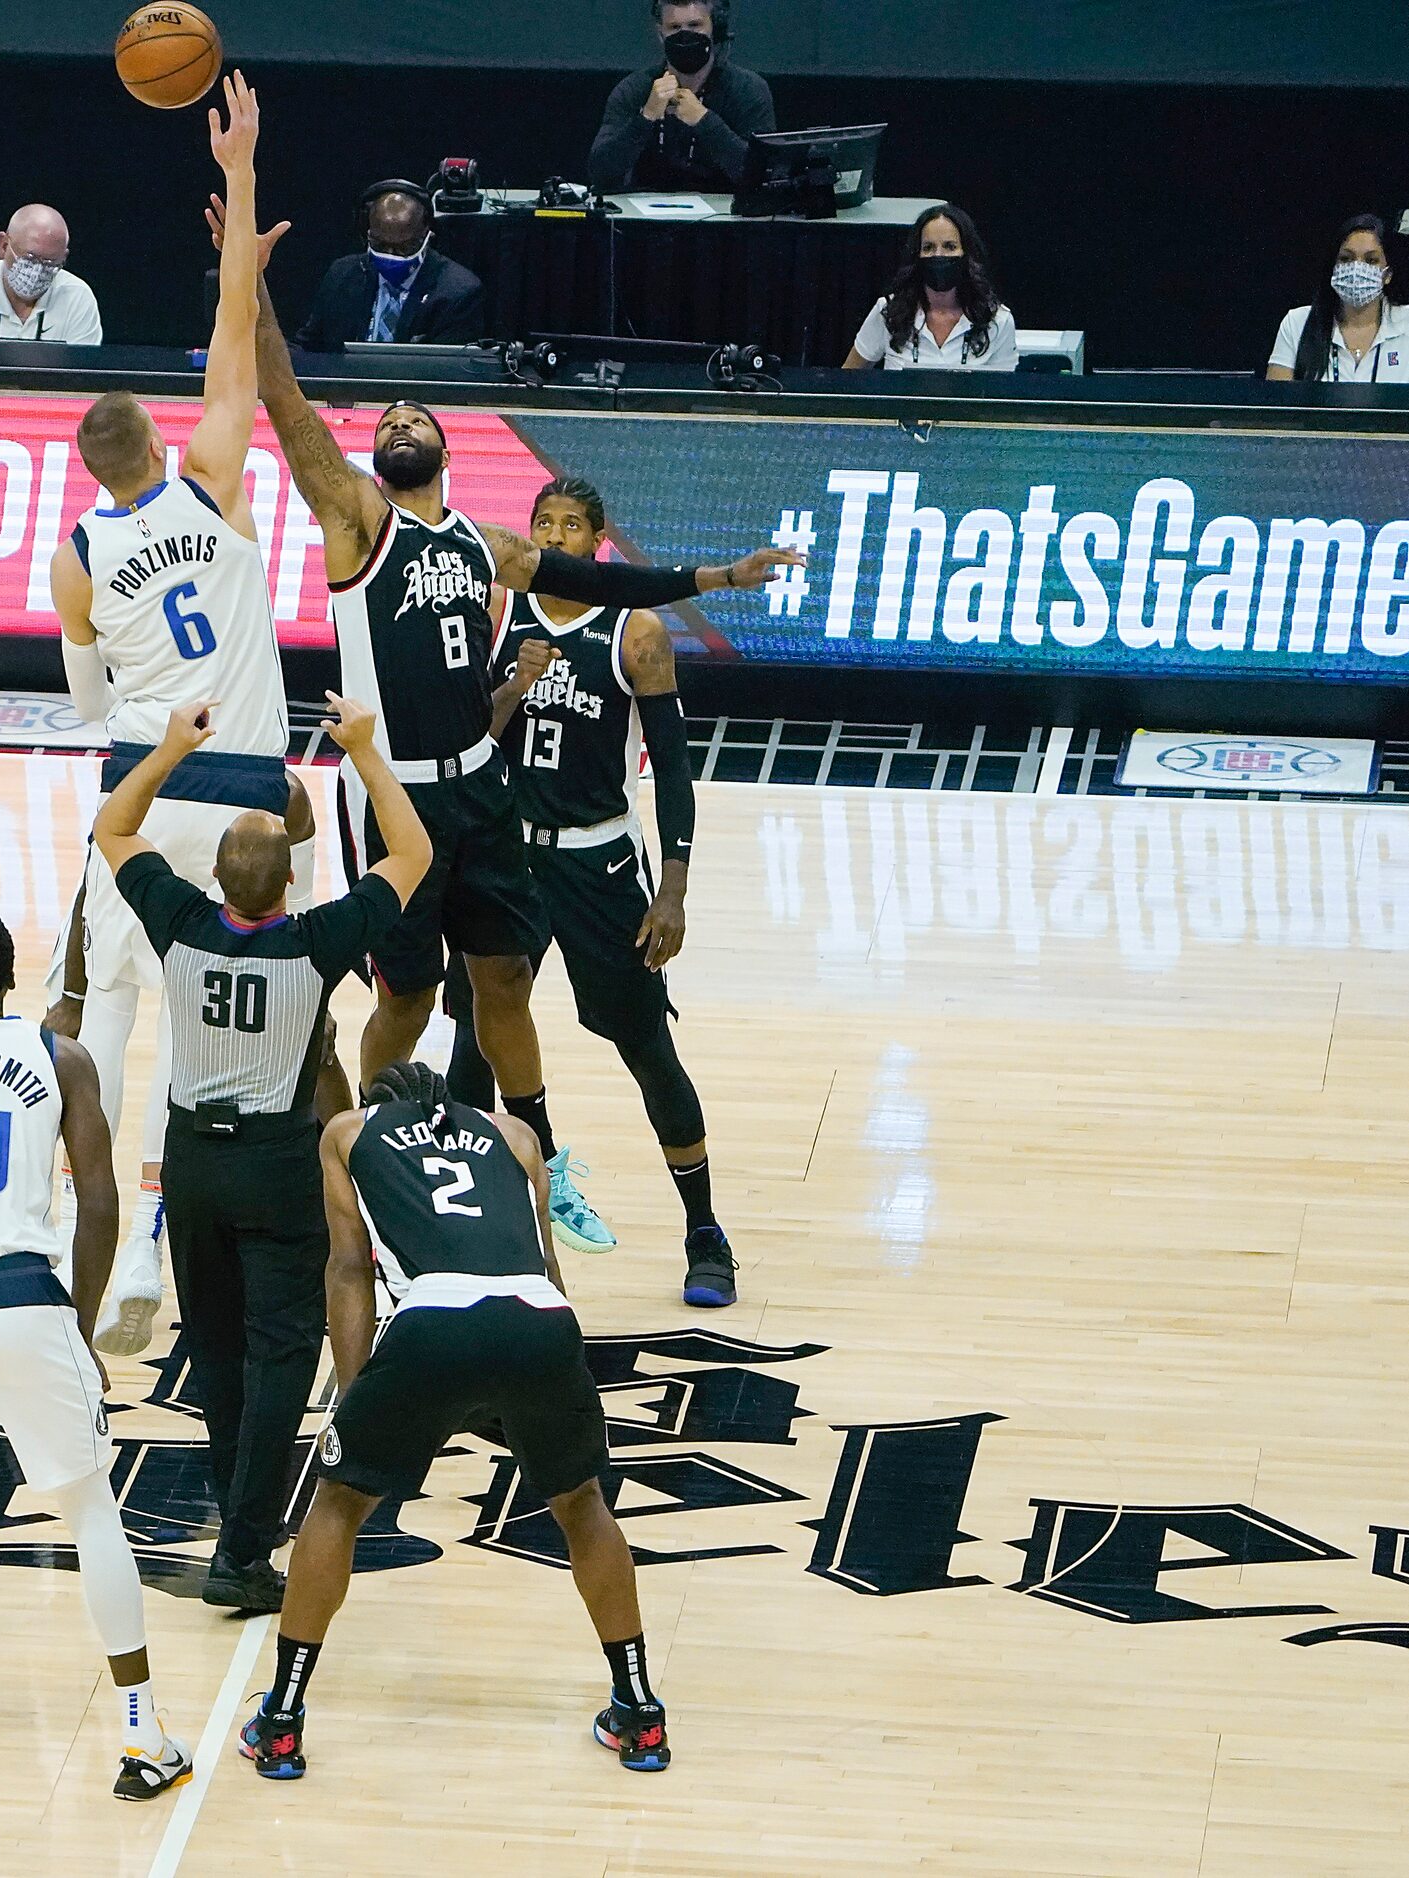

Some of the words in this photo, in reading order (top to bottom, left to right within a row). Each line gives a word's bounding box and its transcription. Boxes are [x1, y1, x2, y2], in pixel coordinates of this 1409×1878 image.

[108, 533, 218, 600] PORZINGIS
[420, 543, 465, 576] Los
[163, 580, 217, 660] 6
[439, 614, 470, 670] 8
[522, 717, 563, 770] 13
[201, 969, 268, 1034] 30
[422, 1156, 483, 1218] 2
